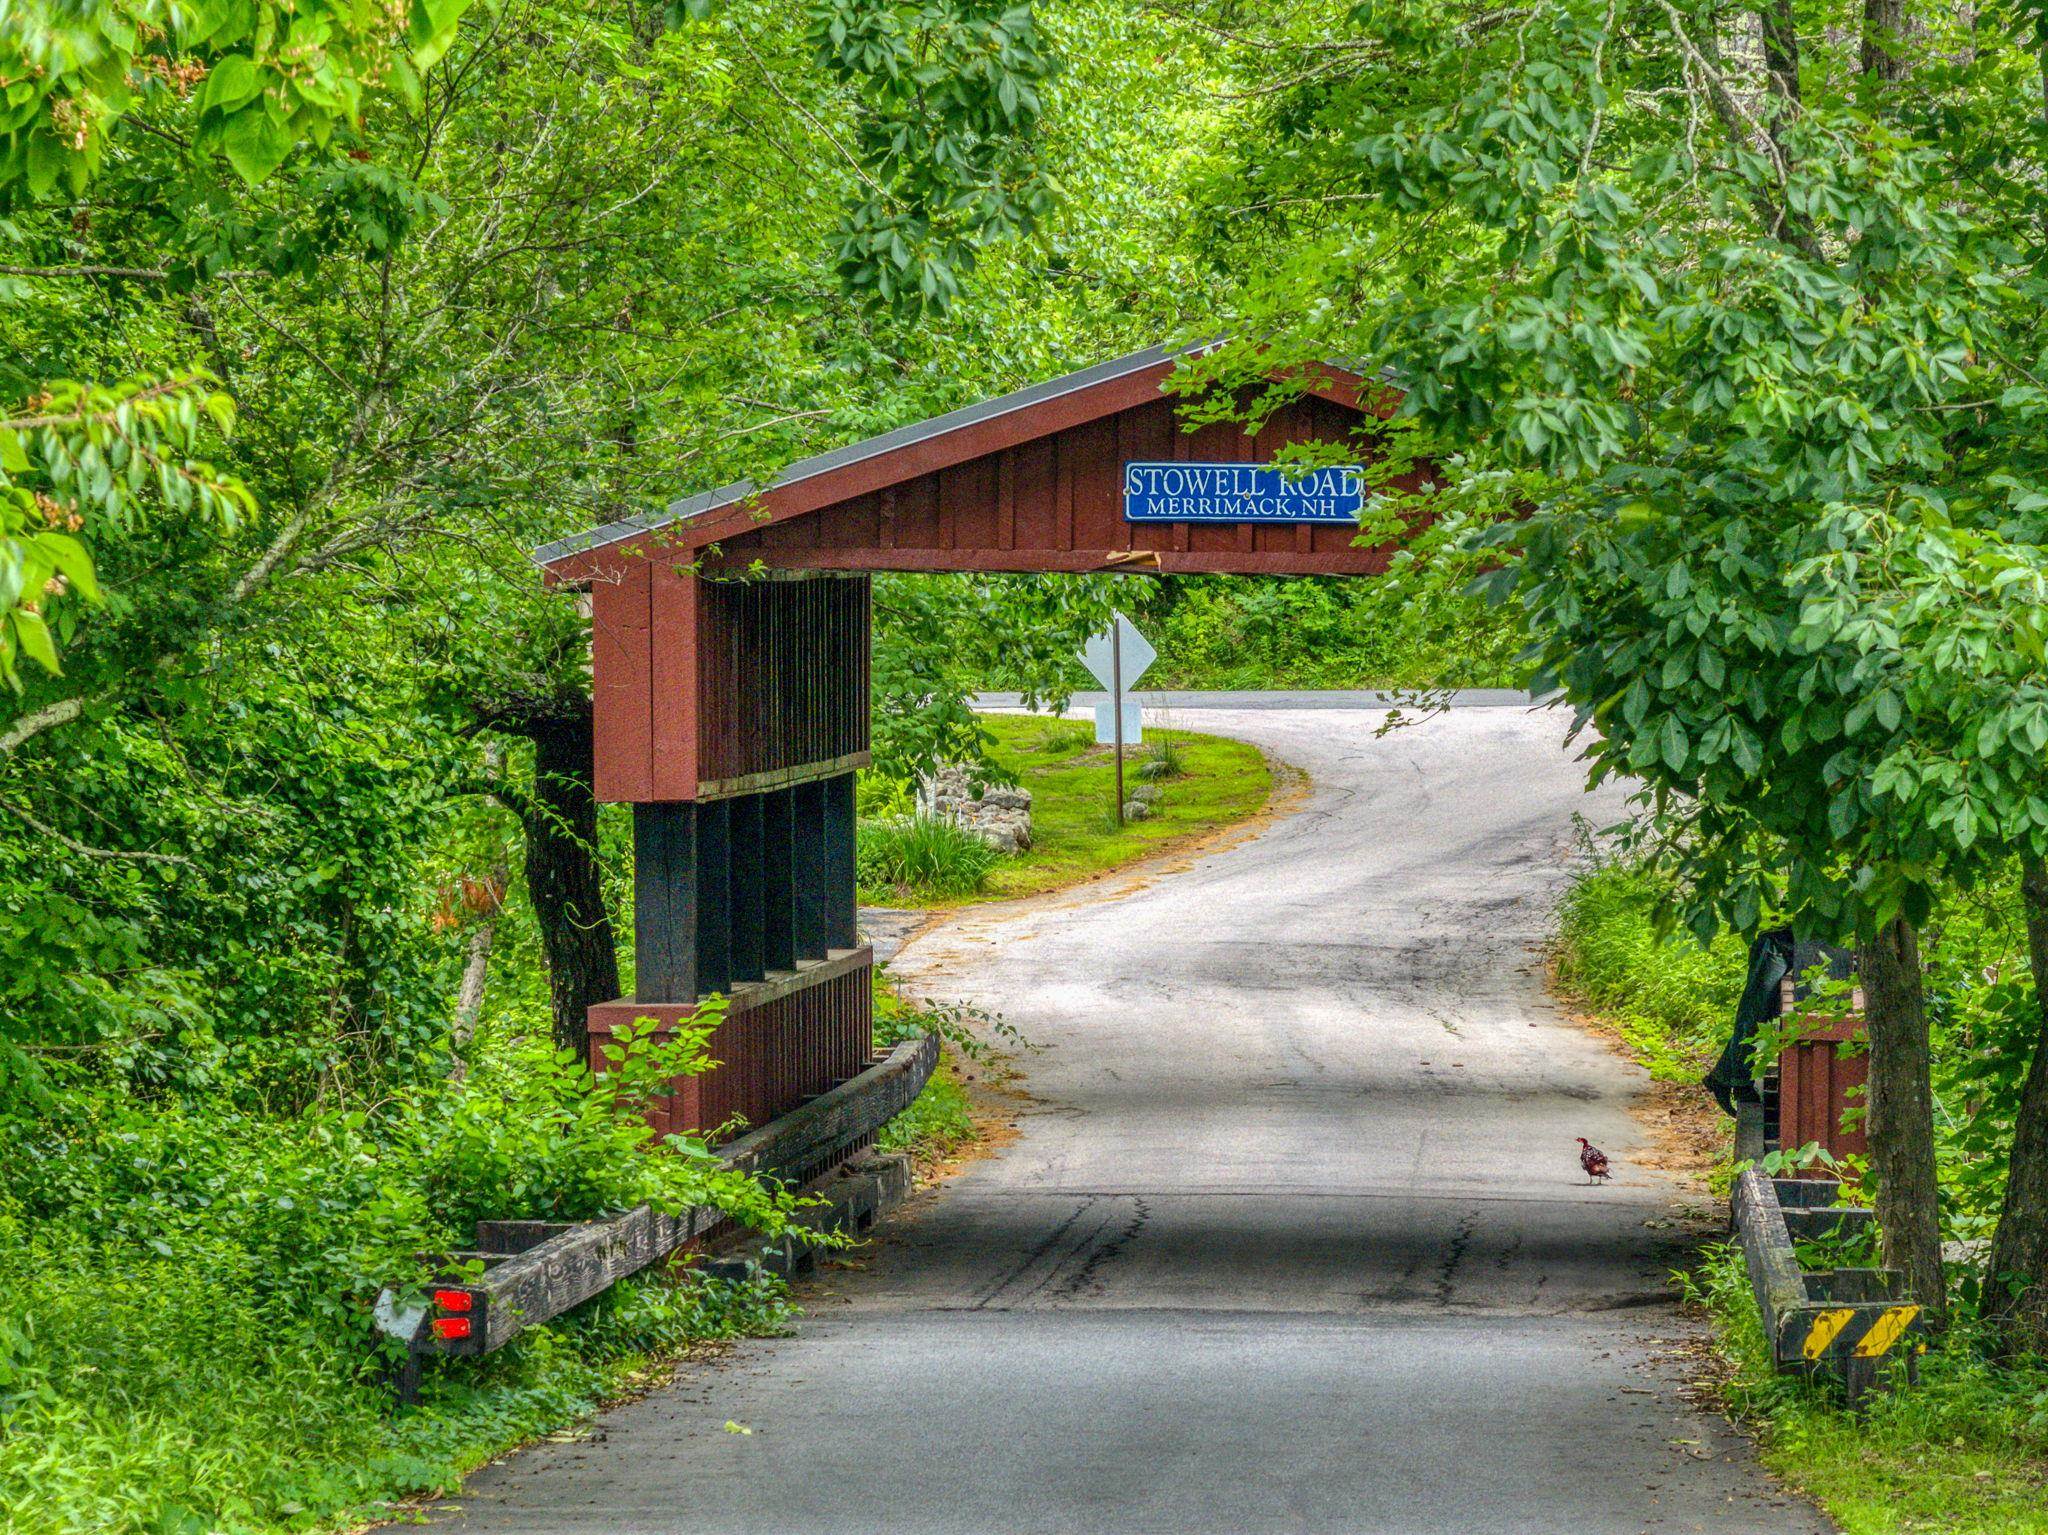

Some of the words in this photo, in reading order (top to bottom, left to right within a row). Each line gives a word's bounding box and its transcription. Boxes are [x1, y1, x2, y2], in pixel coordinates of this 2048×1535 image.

[1129, 468, 1266, 497] STOWELL
[1147, 498, 1297, 517] MERRIMACK,
[1301, 499, 1336, 516] NH
